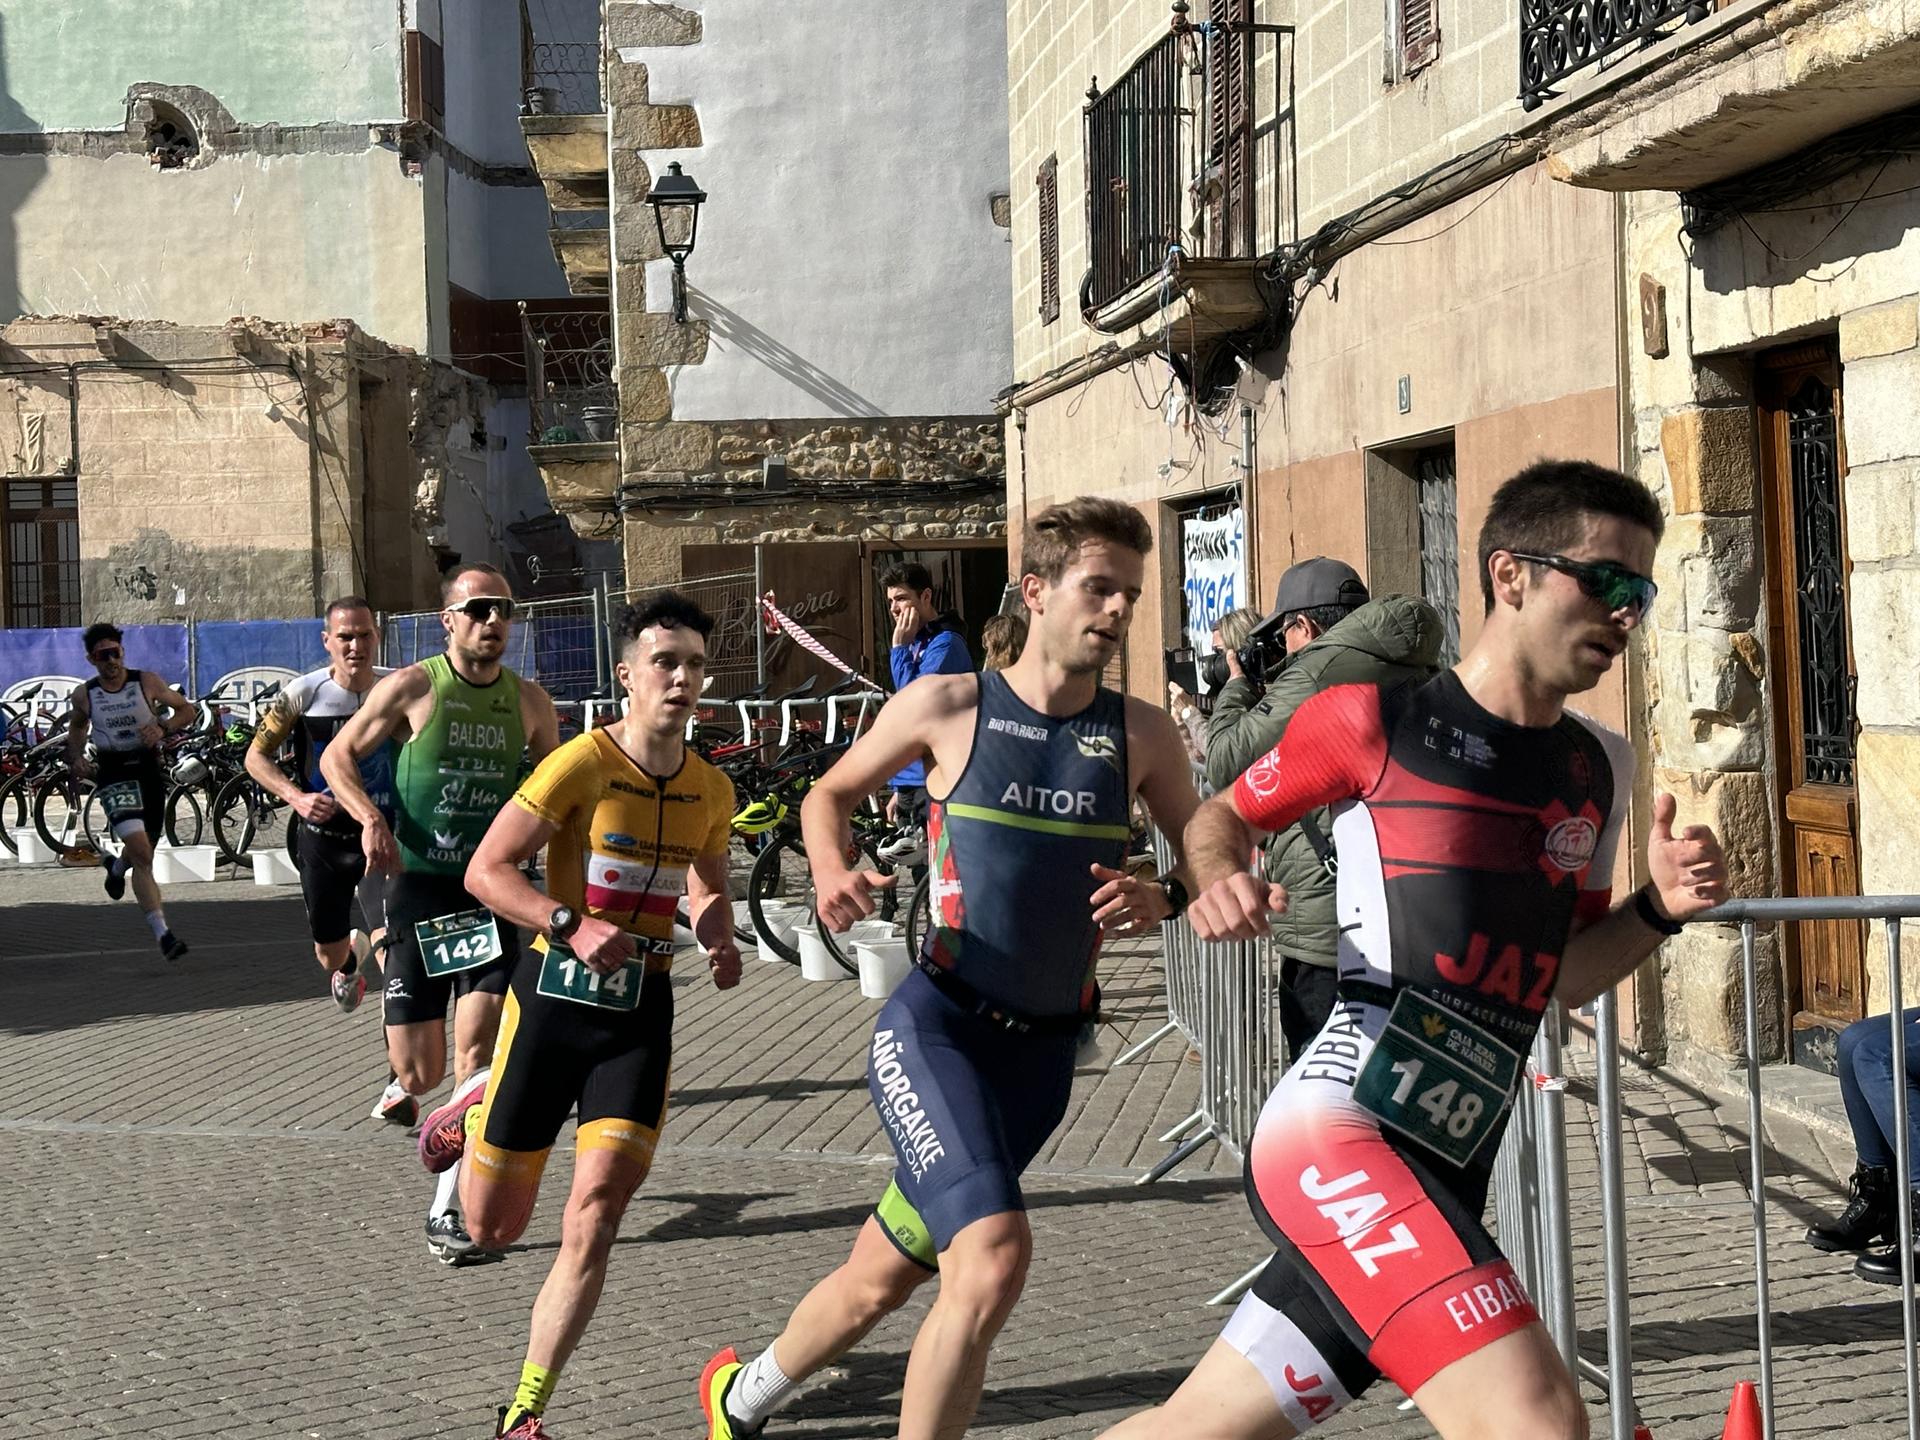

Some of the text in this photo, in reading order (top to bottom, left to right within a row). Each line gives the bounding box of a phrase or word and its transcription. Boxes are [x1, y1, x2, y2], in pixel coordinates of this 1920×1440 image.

[448, 721, 507, 751] BALBOA
[107, 793, 137, 807] 123
[1000, 781, 1097, 817] AITOR
[426, 847, 463, 863] KOM
[433, 934, 491, 965] 142
[558, 957, 629, 998] 114
[1433, 931, 1560, 1014] JAZ
[1431, 988, 1498, 1024] SURFACE
[1390, 1058, 1484, 1138] 148
[879, 1096, 923, 1184] TRIATLOIA
[1300, 1164, 1420, 1279] JAZ
